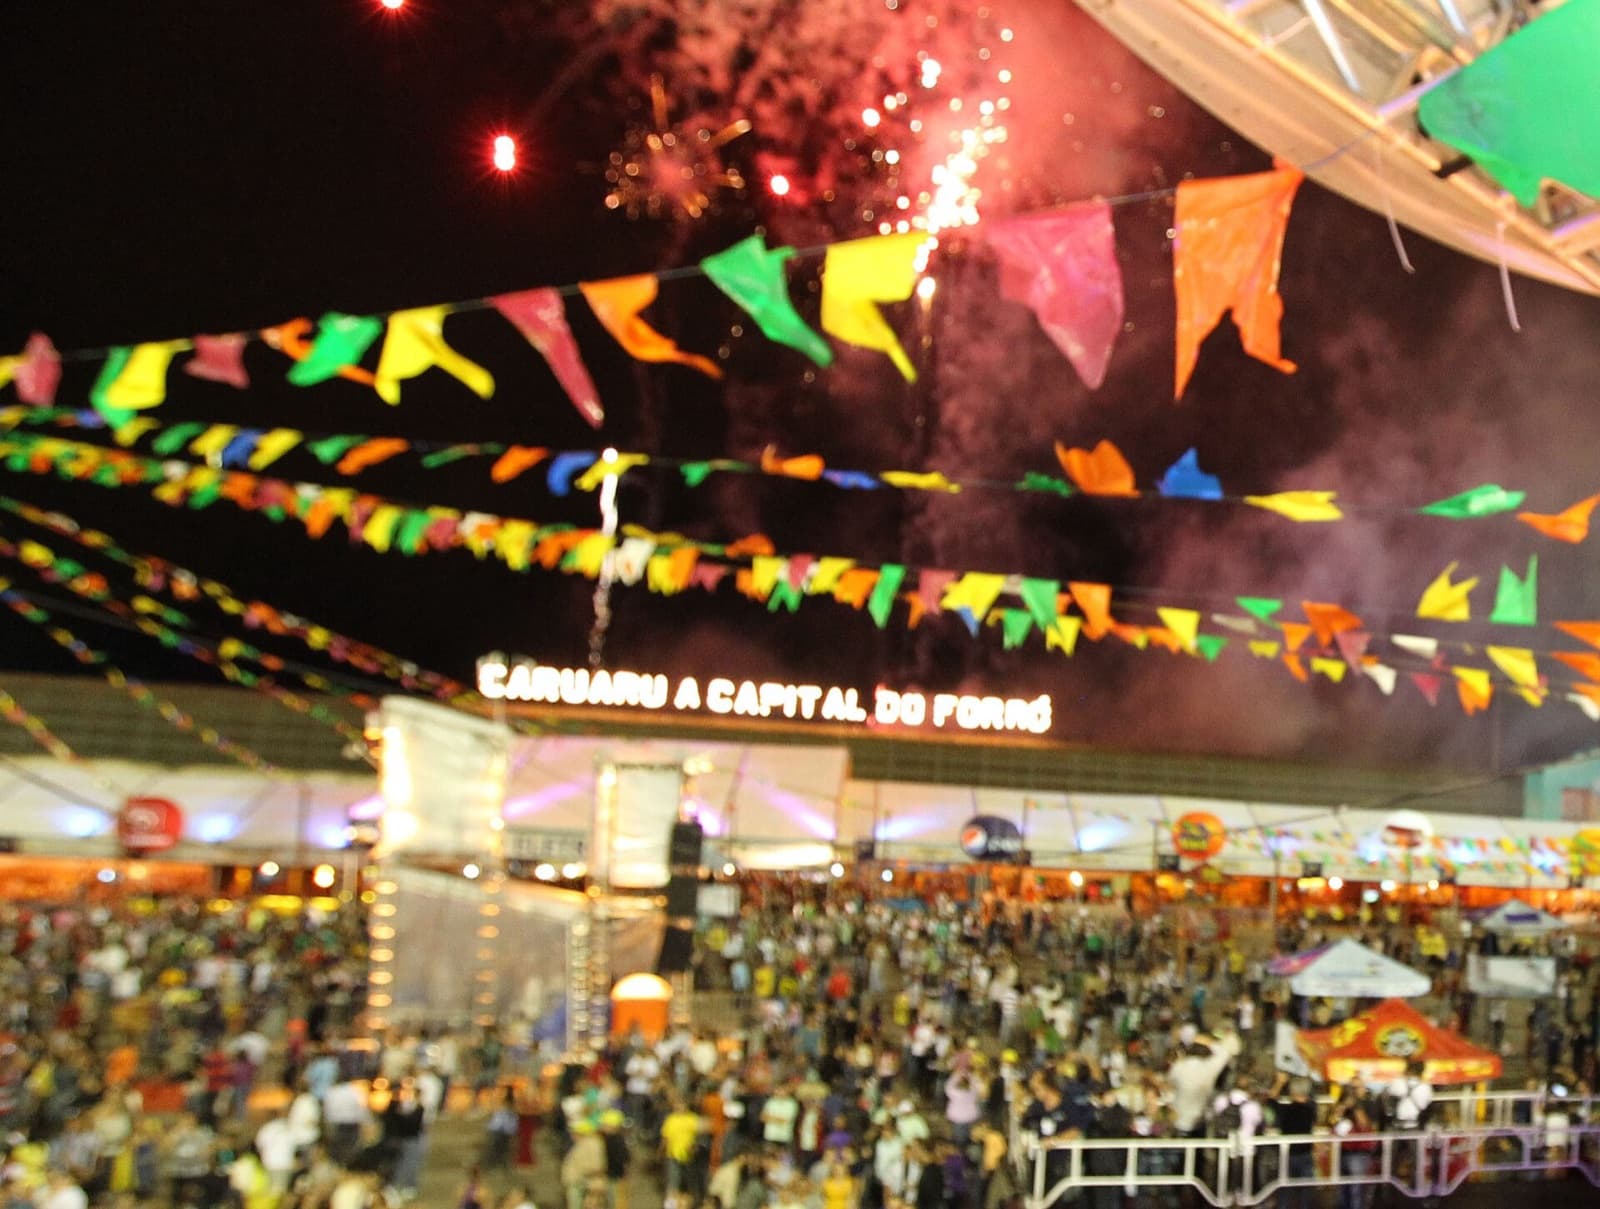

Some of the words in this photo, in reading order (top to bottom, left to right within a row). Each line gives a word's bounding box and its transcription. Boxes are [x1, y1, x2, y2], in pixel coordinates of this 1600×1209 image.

[478, 664, 668, 708] CARUARU
[673, 677, 701, 709] A
[706, 678, 867, 722] CAPITAL
[875, 689, 926, 726] DO
